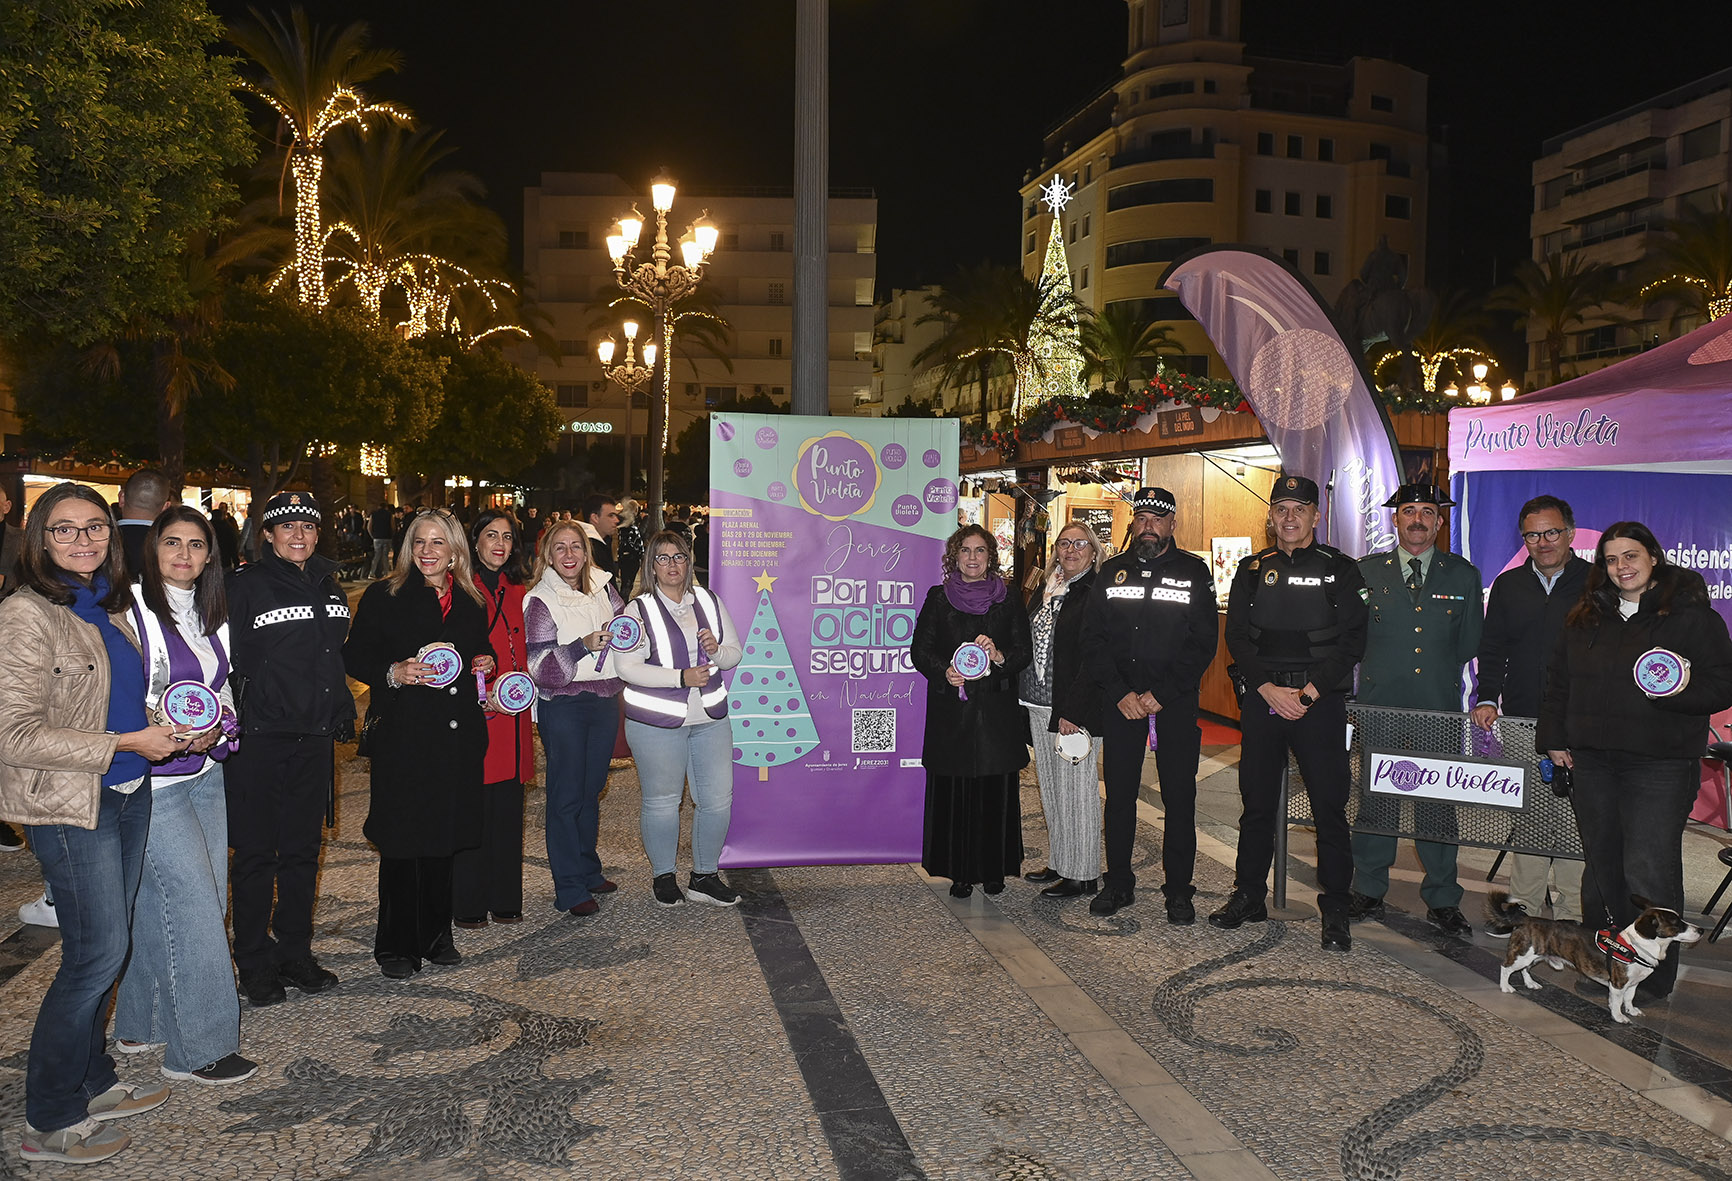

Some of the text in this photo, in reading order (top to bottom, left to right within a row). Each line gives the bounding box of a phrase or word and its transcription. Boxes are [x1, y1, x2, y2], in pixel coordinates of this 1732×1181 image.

[571, 421, 613, 434] OCASO
[1463, 408, 1620, 461] Punto Violeta
[811, 444, 864, 480] Punto
[810, 479, 864, 504] Violeta
[722, 521, 760, 529] PLAZA ARENAL
[824, 525, 906, 574] Jerez
[811, 575, 914, 605] Por un
[810, 680, 915, 709] en Navidad
[1374, 759, 1521, 797] Punto Violeta
